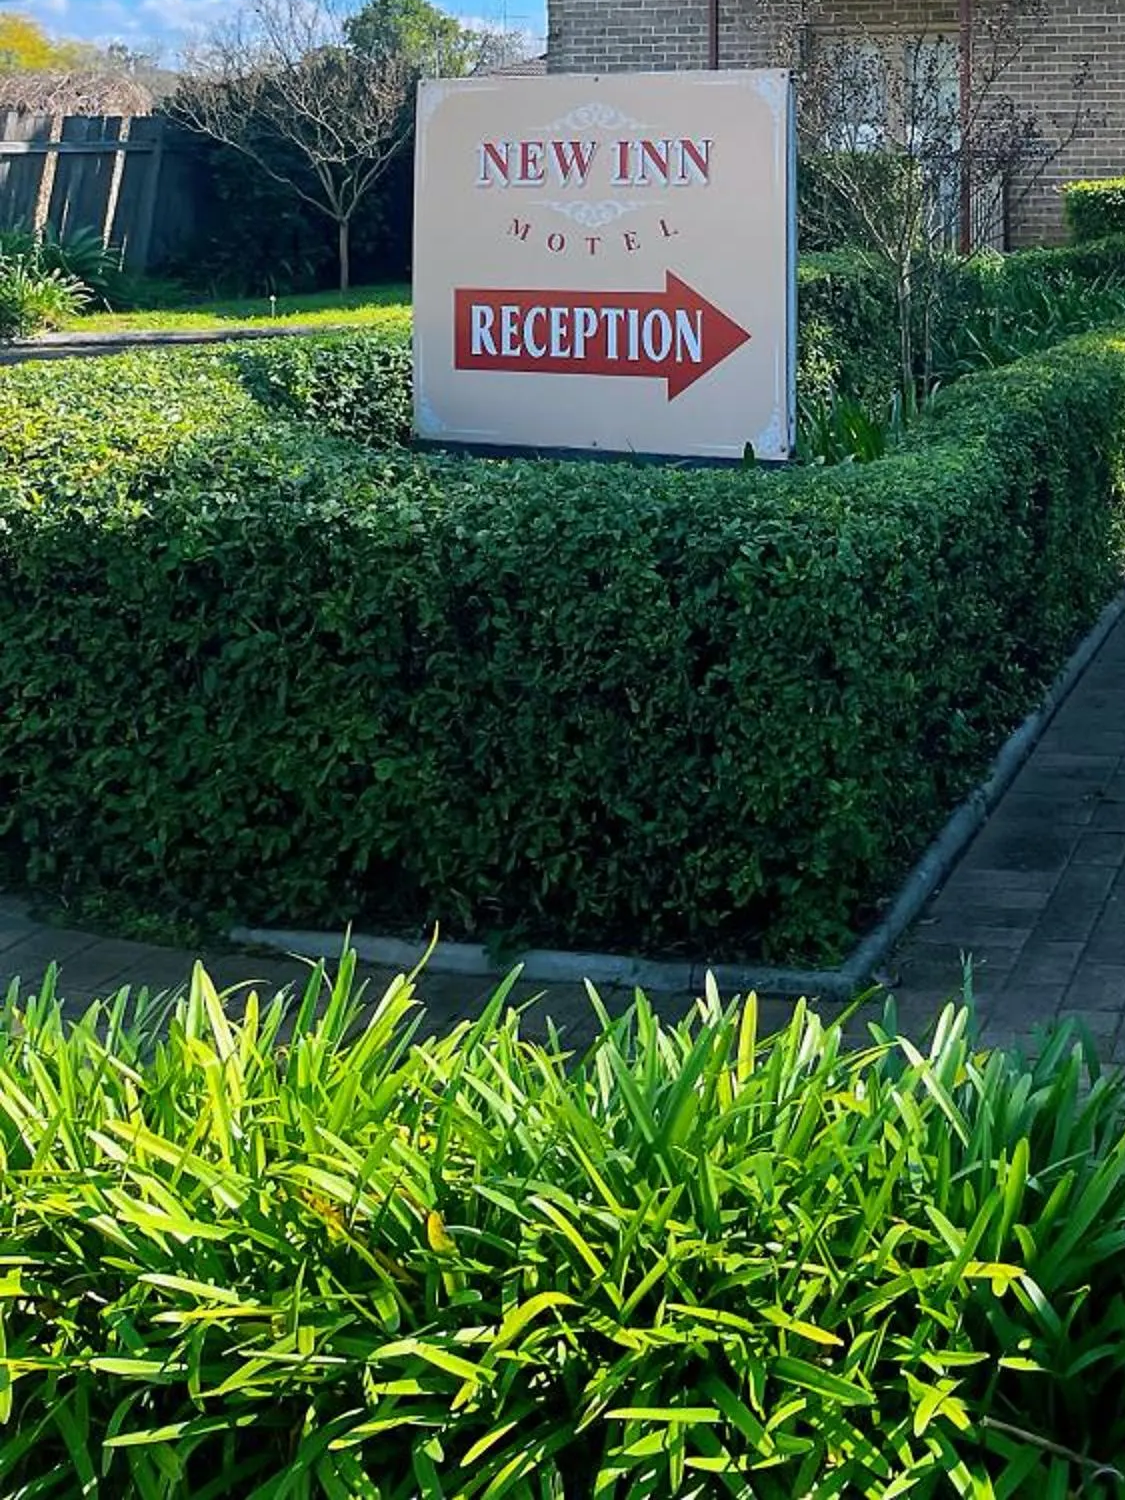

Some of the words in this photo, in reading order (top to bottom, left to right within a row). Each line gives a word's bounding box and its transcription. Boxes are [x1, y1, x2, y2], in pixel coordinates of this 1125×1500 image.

[477, 139, 597, 188] NEW
[611, 138, 713, 187] INN
[507, 218, 679, 256] MOTEL
[470, 304, 704, 364] RECEPTION
